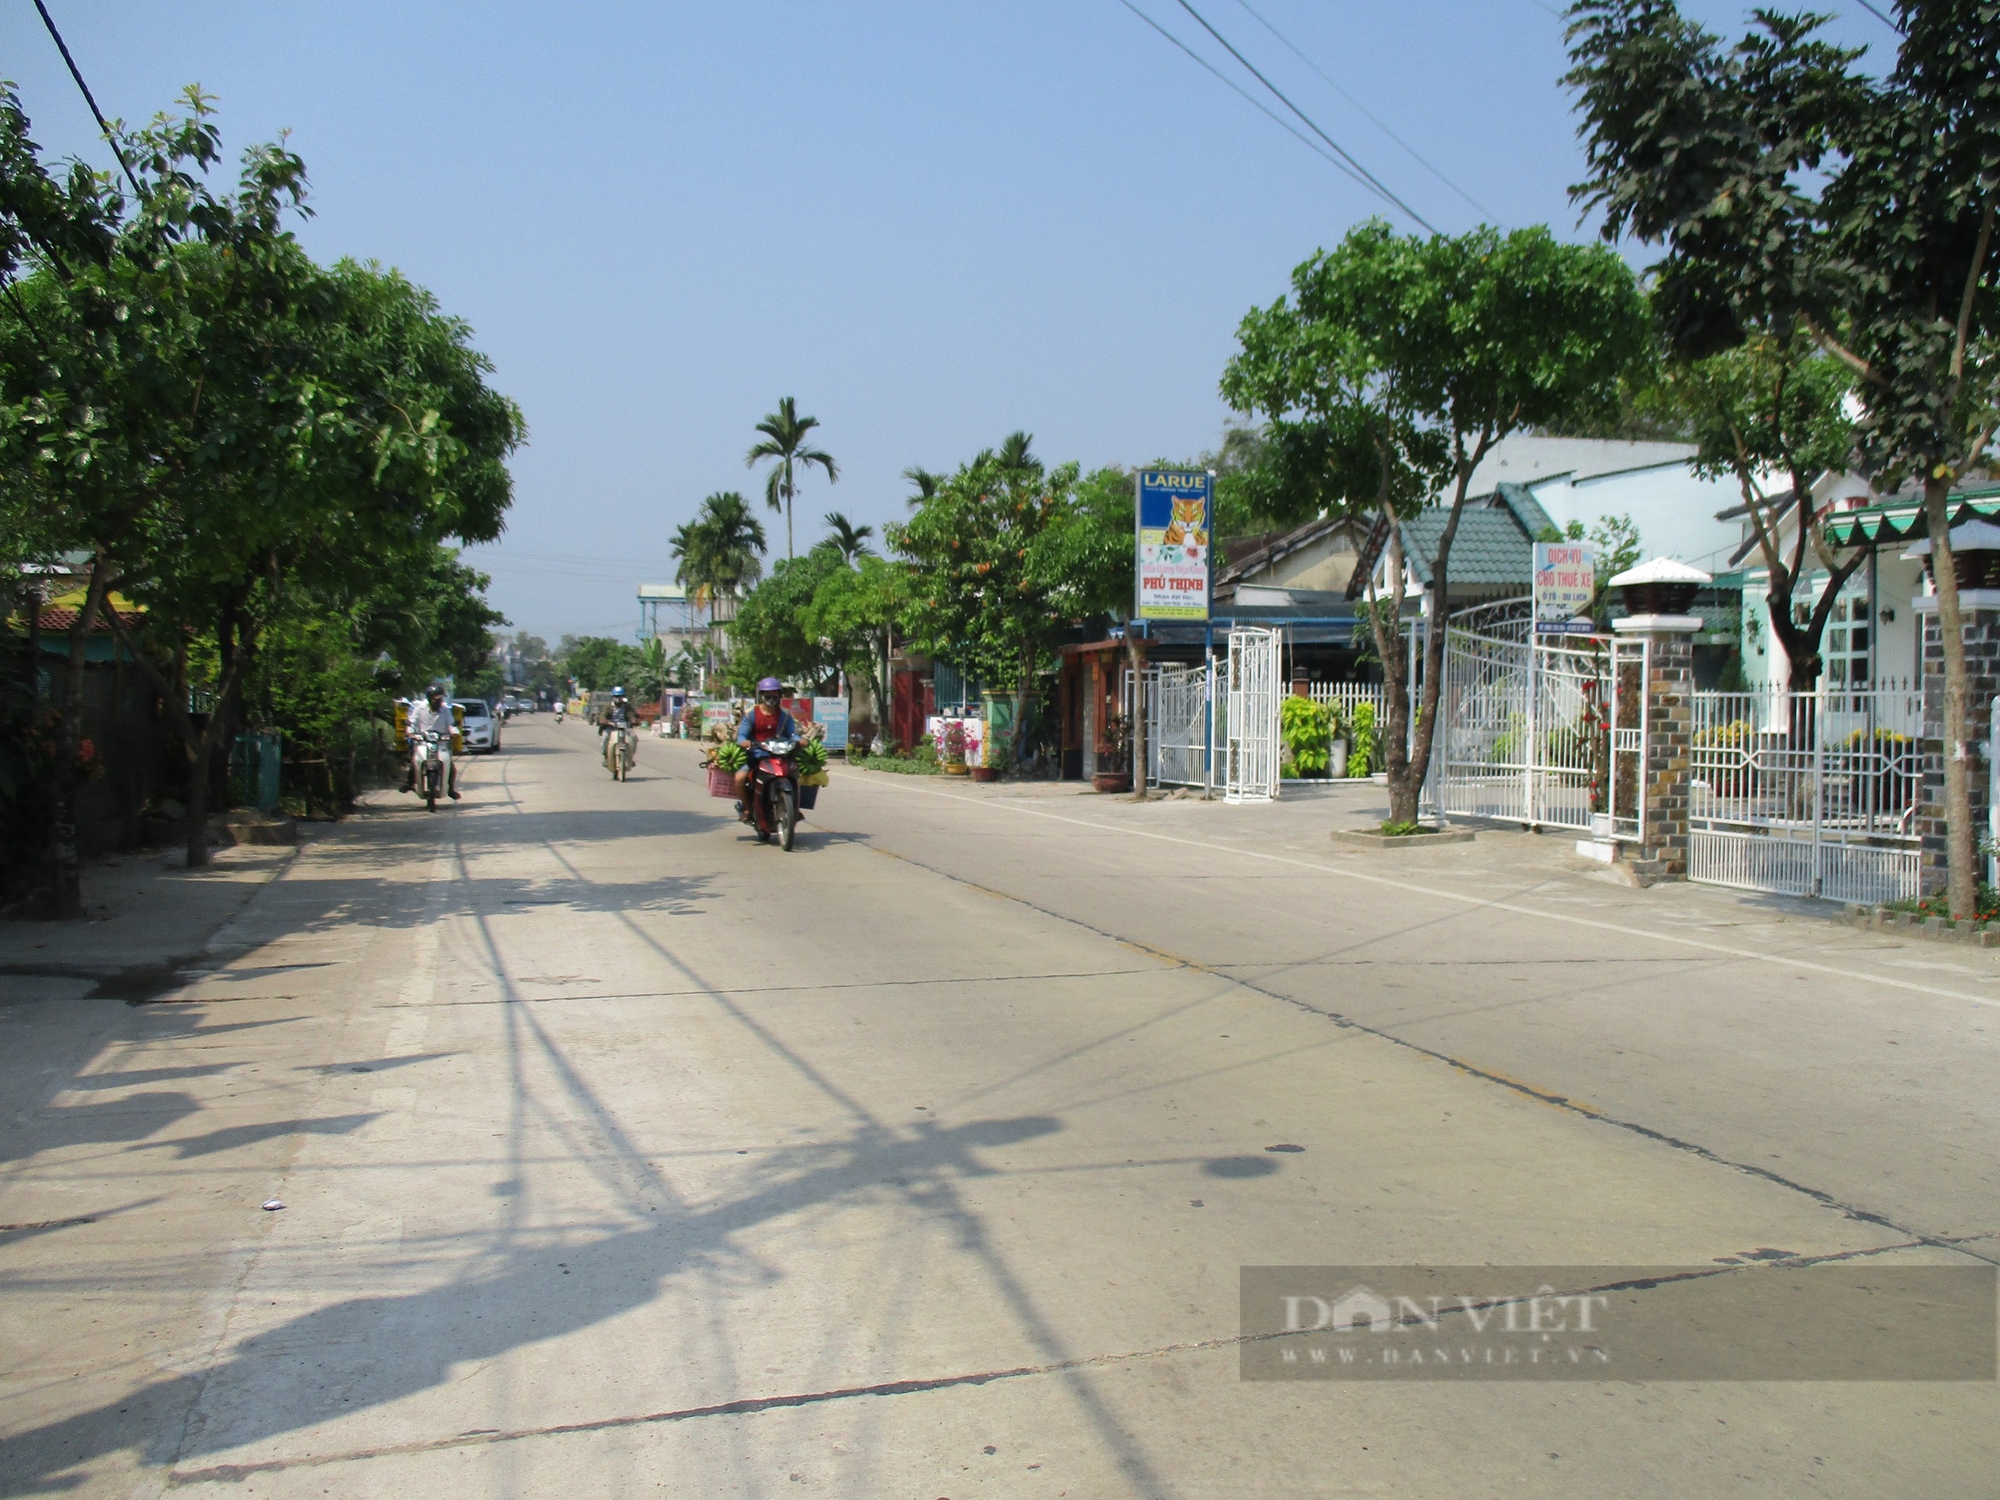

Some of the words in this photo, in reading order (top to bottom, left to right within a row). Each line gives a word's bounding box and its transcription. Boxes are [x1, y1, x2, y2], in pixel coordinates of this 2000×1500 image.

[1145, 474, 1205, 488] LARUE
[1143, 574, 1166, 590] PHÚ
[1168, 577, 1204, 593] THỊNH
[1538, 570, 1554, 587] CHO
[1581, 571, 1592, 588] XE
